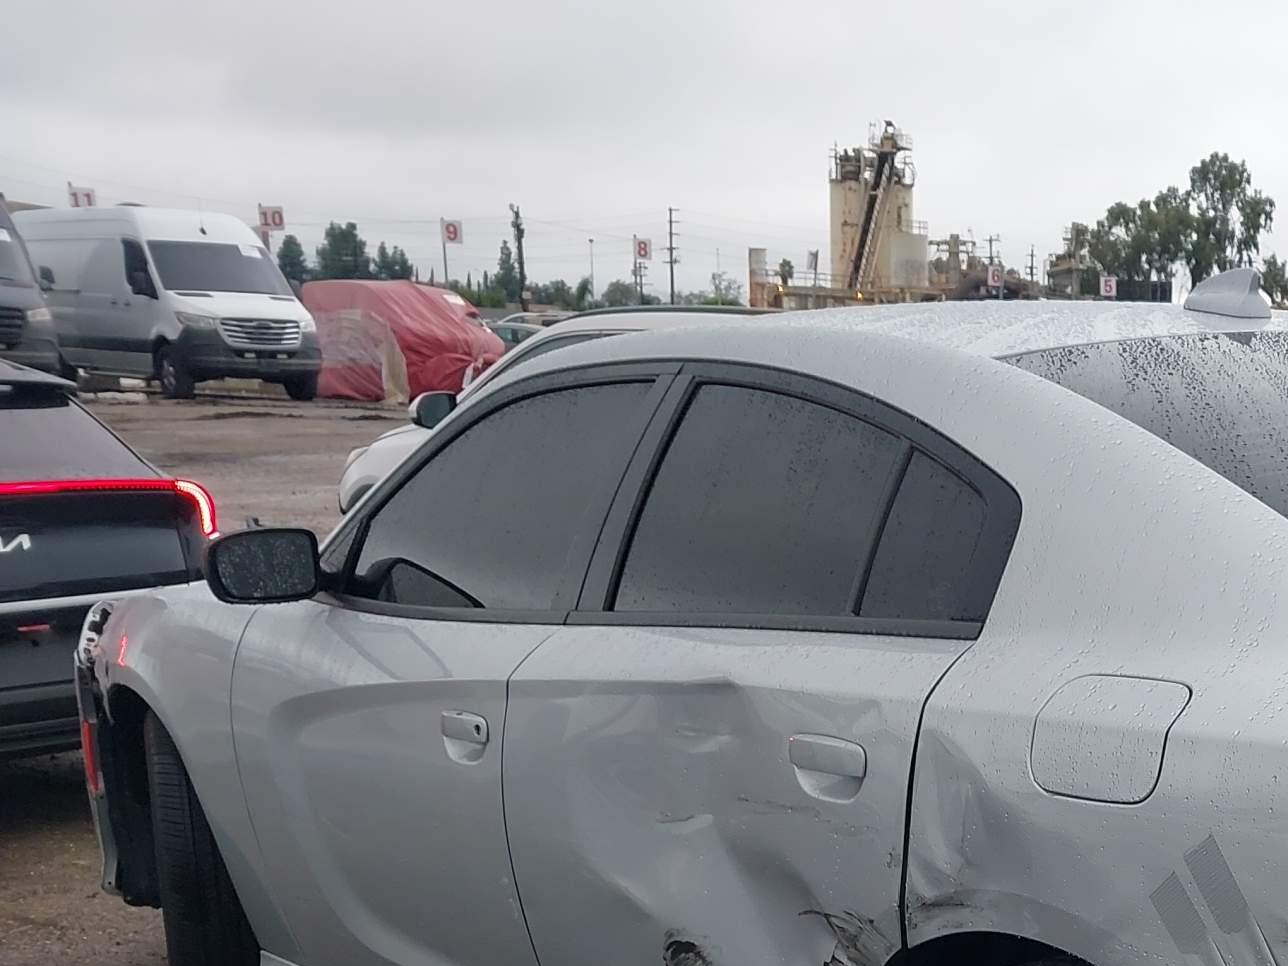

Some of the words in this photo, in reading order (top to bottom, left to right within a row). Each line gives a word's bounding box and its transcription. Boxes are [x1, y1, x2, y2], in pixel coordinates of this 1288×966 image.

[71, 192, 94, 208] 11
[260, 210, 284, 227] 10
[445, 223, 458, 241] 9
[637, 240, 648, 257] 8
[991, 268, 1001, 283] 6
[1104, 279, 1113, 293] 5
